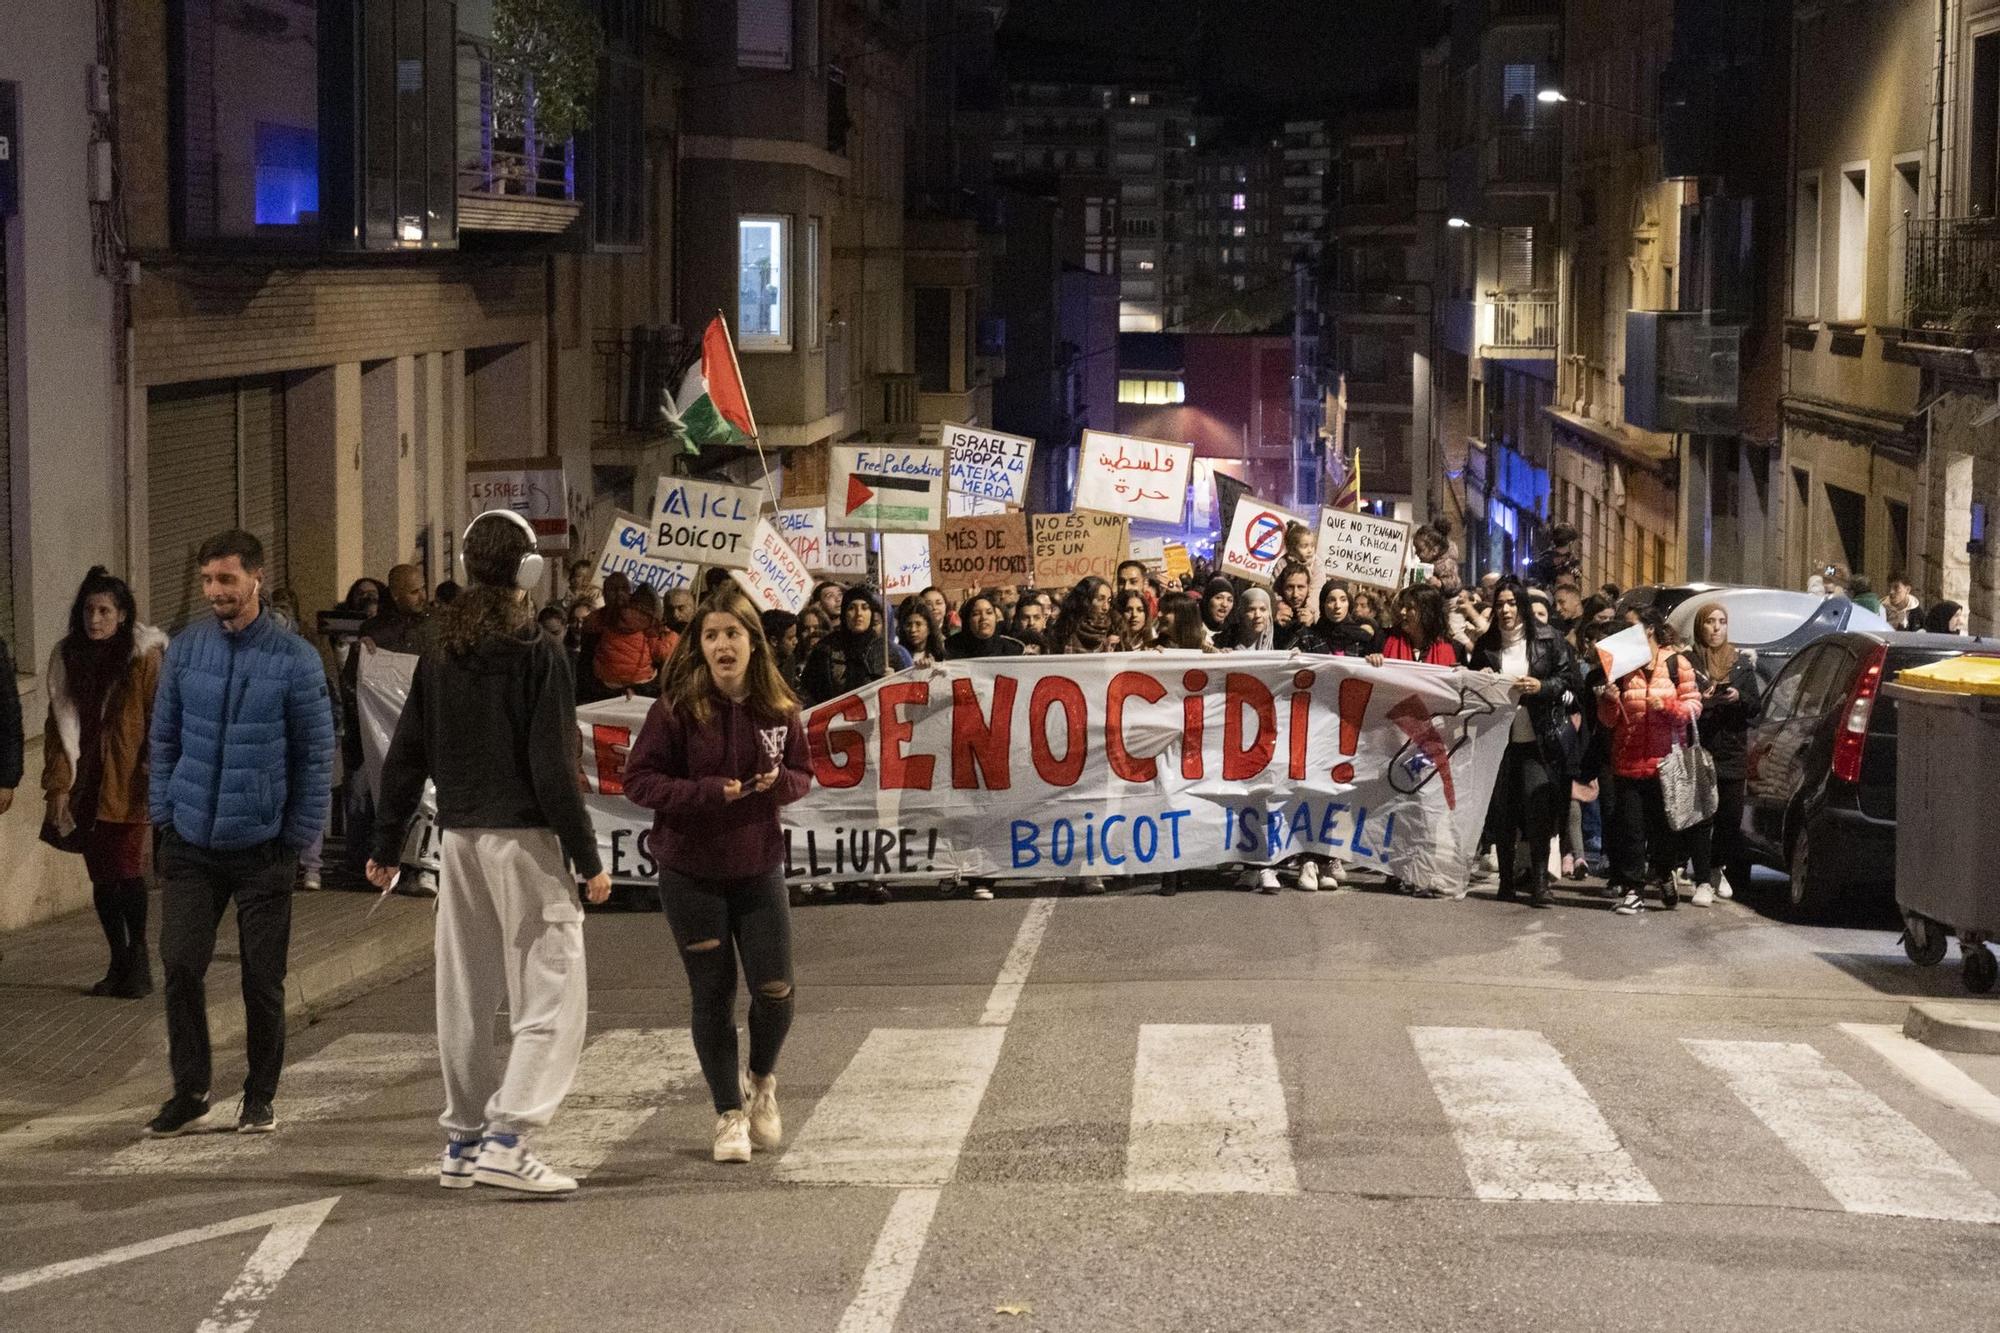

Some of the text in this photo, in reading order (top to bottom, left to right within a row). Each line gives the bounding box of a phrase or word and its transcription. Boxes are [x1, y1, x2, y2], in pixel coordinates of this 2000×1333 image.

[952, 433, 1027, 458] ISRAEL I
[856, 452, 881, 471] Free
[949, 447, 1024, 474] EUROPA LA
[1099, 446, 1175, 473] فلسطين
[472, 483, 527, 498] ISRAEL
[961, 479, 1014, 504] MERDA
[1114, 478, 1170, 502] حرة
[1035, 517, 1059, 530] NO
[1093, 516, 1122, 527] UNA
[1327, 516, 1346, 529] QUE
[1350, 520, 1363, 532] NO
[944, 528, 978, 551] MÉS
[985, 529, 1006, 550] DE
[1036, 529, 1090, 543] GUERRA
[1337, 532, 1397, 555] LA RAHOLA
[1063, 543, 1084, 555] UN
[939, 556, 985, 573] 13.000
[988, 555, 1027, 574] MORTS
[1225, 801, 1396, 863] ISRAEL!
